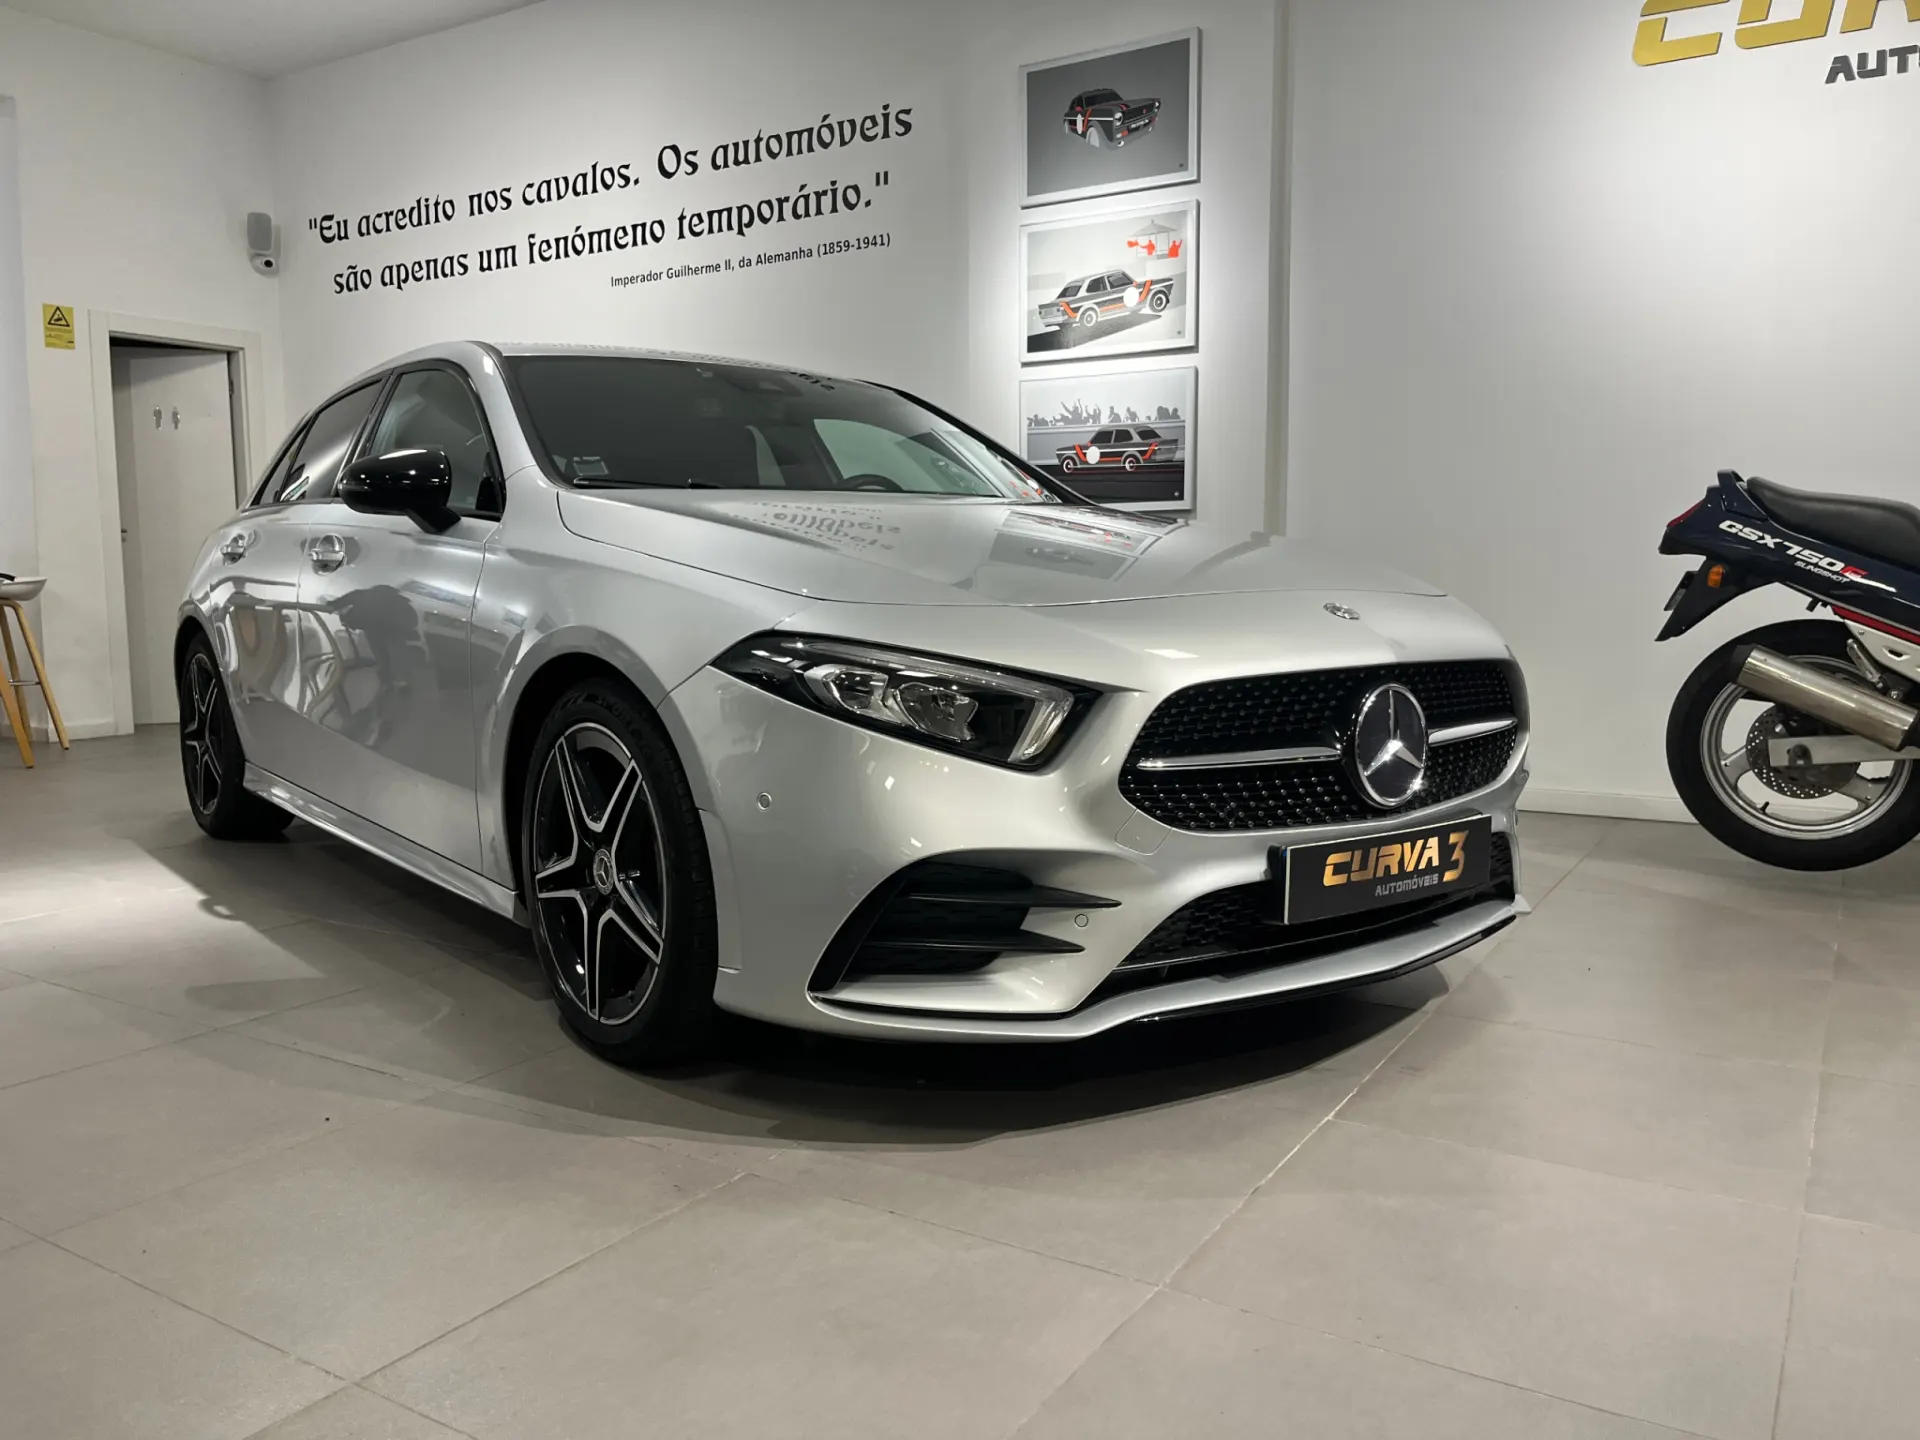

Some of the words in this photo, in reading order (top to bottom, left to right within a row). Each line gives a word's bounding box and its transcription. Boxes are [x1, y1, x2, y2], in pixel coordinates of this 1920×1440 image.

[1825, 44, 1920, 84] AUT
[308, 213, 350, 244] "Eu
[357, 195, 455, 238] acredito
[469, 187, 512, 217] nos
[522, 161, 640, 206] cavalos.
[657, 143, 699, 179] Os
[711, 104, 913, 171] automóveis
[333, 264, 372, 294] são
[380, 253, 469, 291] apenas
[478, 244, 518, 273] um
[528, 219, 665, 265] fenómeno
[677, 171, 889, 240] temporário."
[610, 269, 664, 288] Imperador
[666, 260, 721, 280] Guilherme
[724, 259, 735, 272] II,
[738, 255, 753, 269] da
[755, 246, 814, 267] Alemanha
[817, 233, 891, 258] (1859-1941)
[1718, 520, 1783, 549] GSX
[1794, 560, 1850, 584] SLINGSHOT
[1323, 836, 1439, 887] CURVA
[1443, 830, 1468, 882] 3
[1375, 873, 1439, 897] AUTOMÓVEIS
